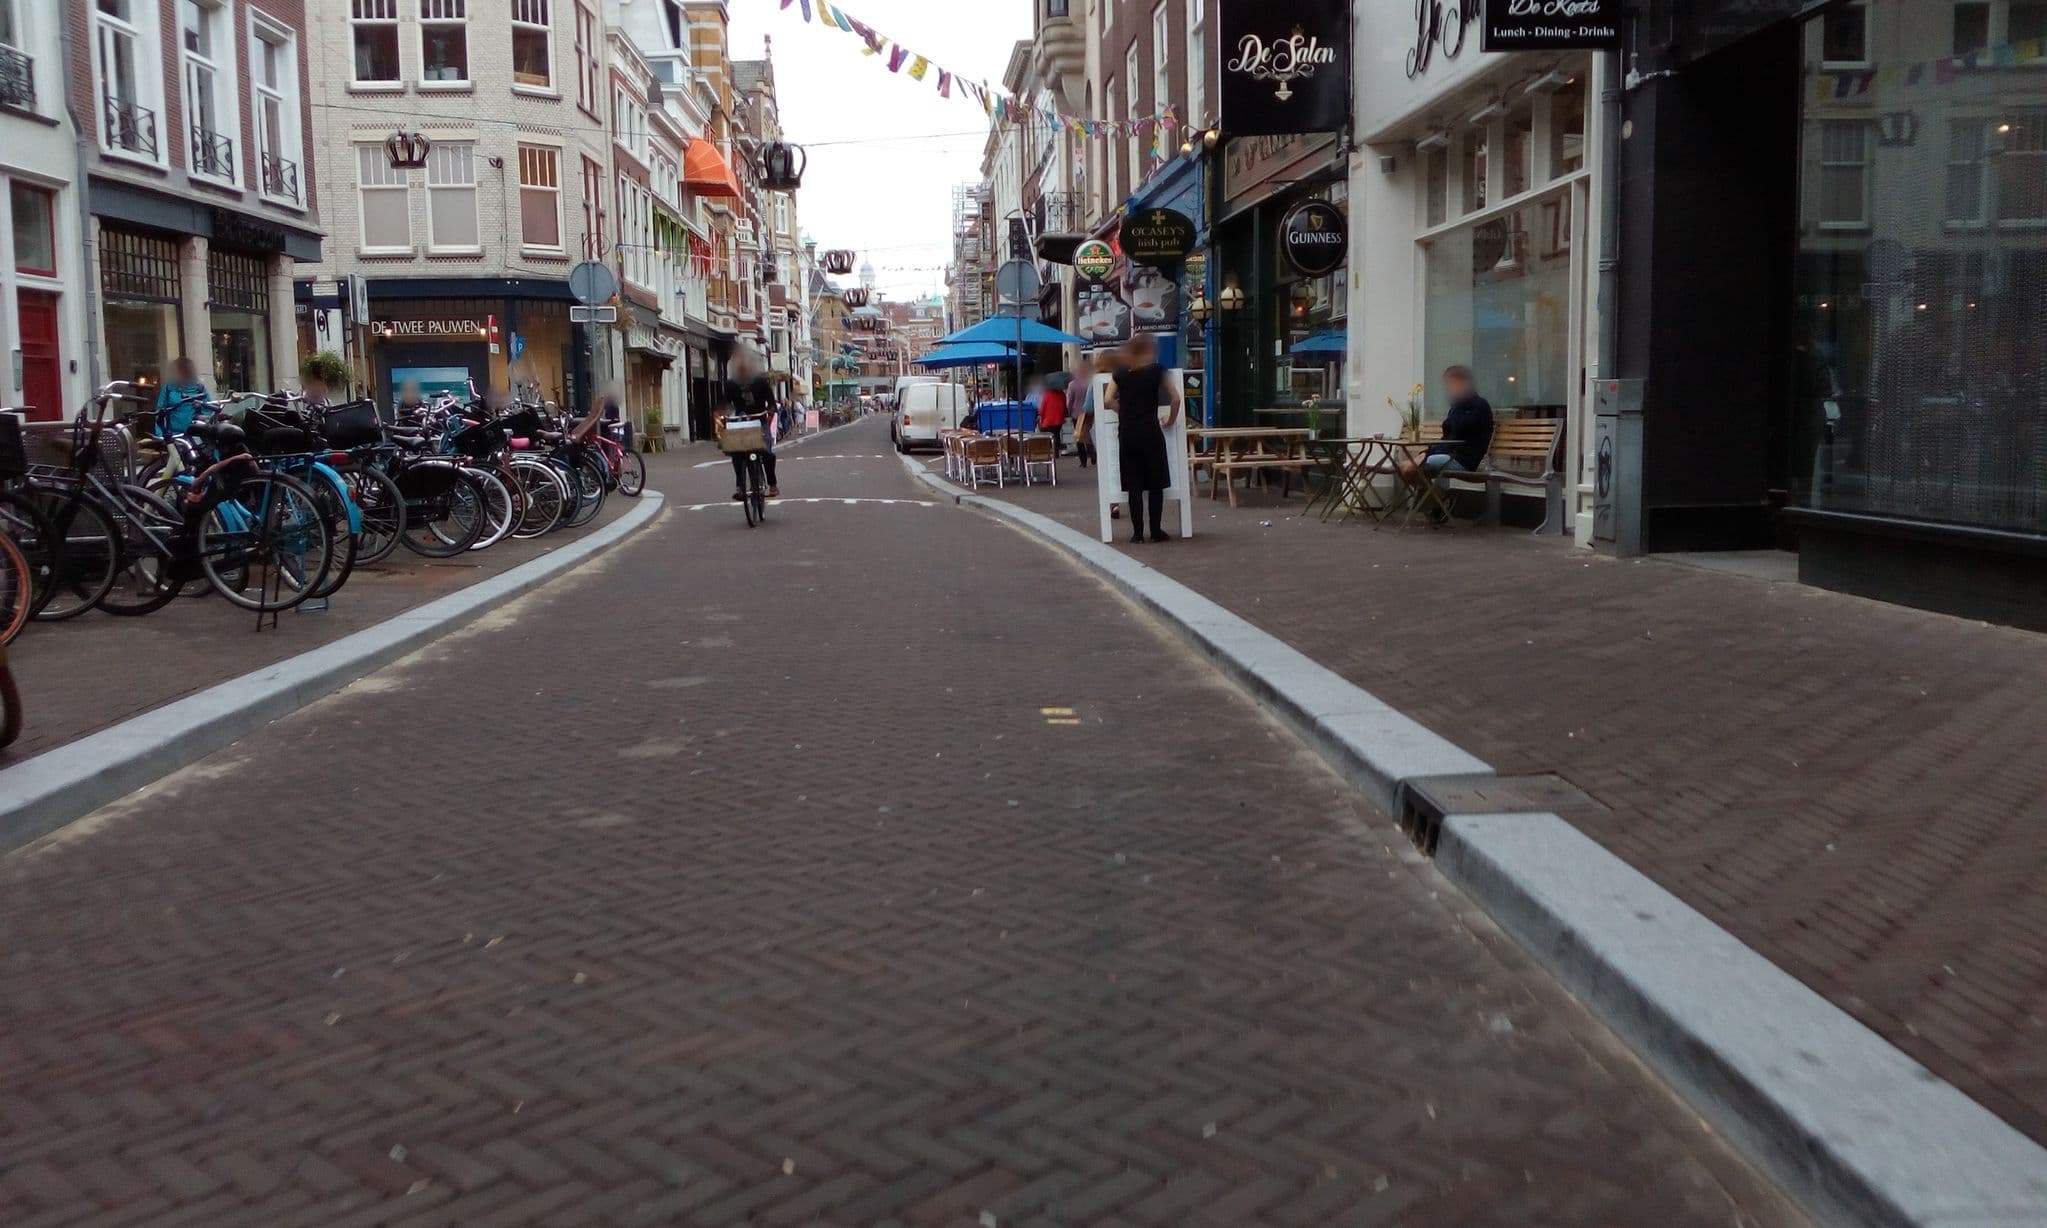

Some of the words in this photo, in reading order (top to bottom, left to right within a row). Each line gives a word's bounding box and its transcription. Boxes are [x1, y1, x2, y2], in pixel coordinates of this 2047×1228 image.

[1493, 27, 1526, 37] Lunch
[1534, 26, 1570, 38] Dining
[1579, 26, 1615, 37] Drinks
[1228, 34, 1271, 71] De
[1273, 35, 1336, 72] Salon
[1131, 225, 1185, 237] O'CASEY'S
[1161, 237, 1180, 249] pub
[1289, 231, 1342, 244] GUINNESS
[1078, 255, 1113, 265] Heineken
[371, 321, 386, 334] DE
[392, 321, 424, 334] TWEE
[429, 320, 480, 333] PAUWEN
